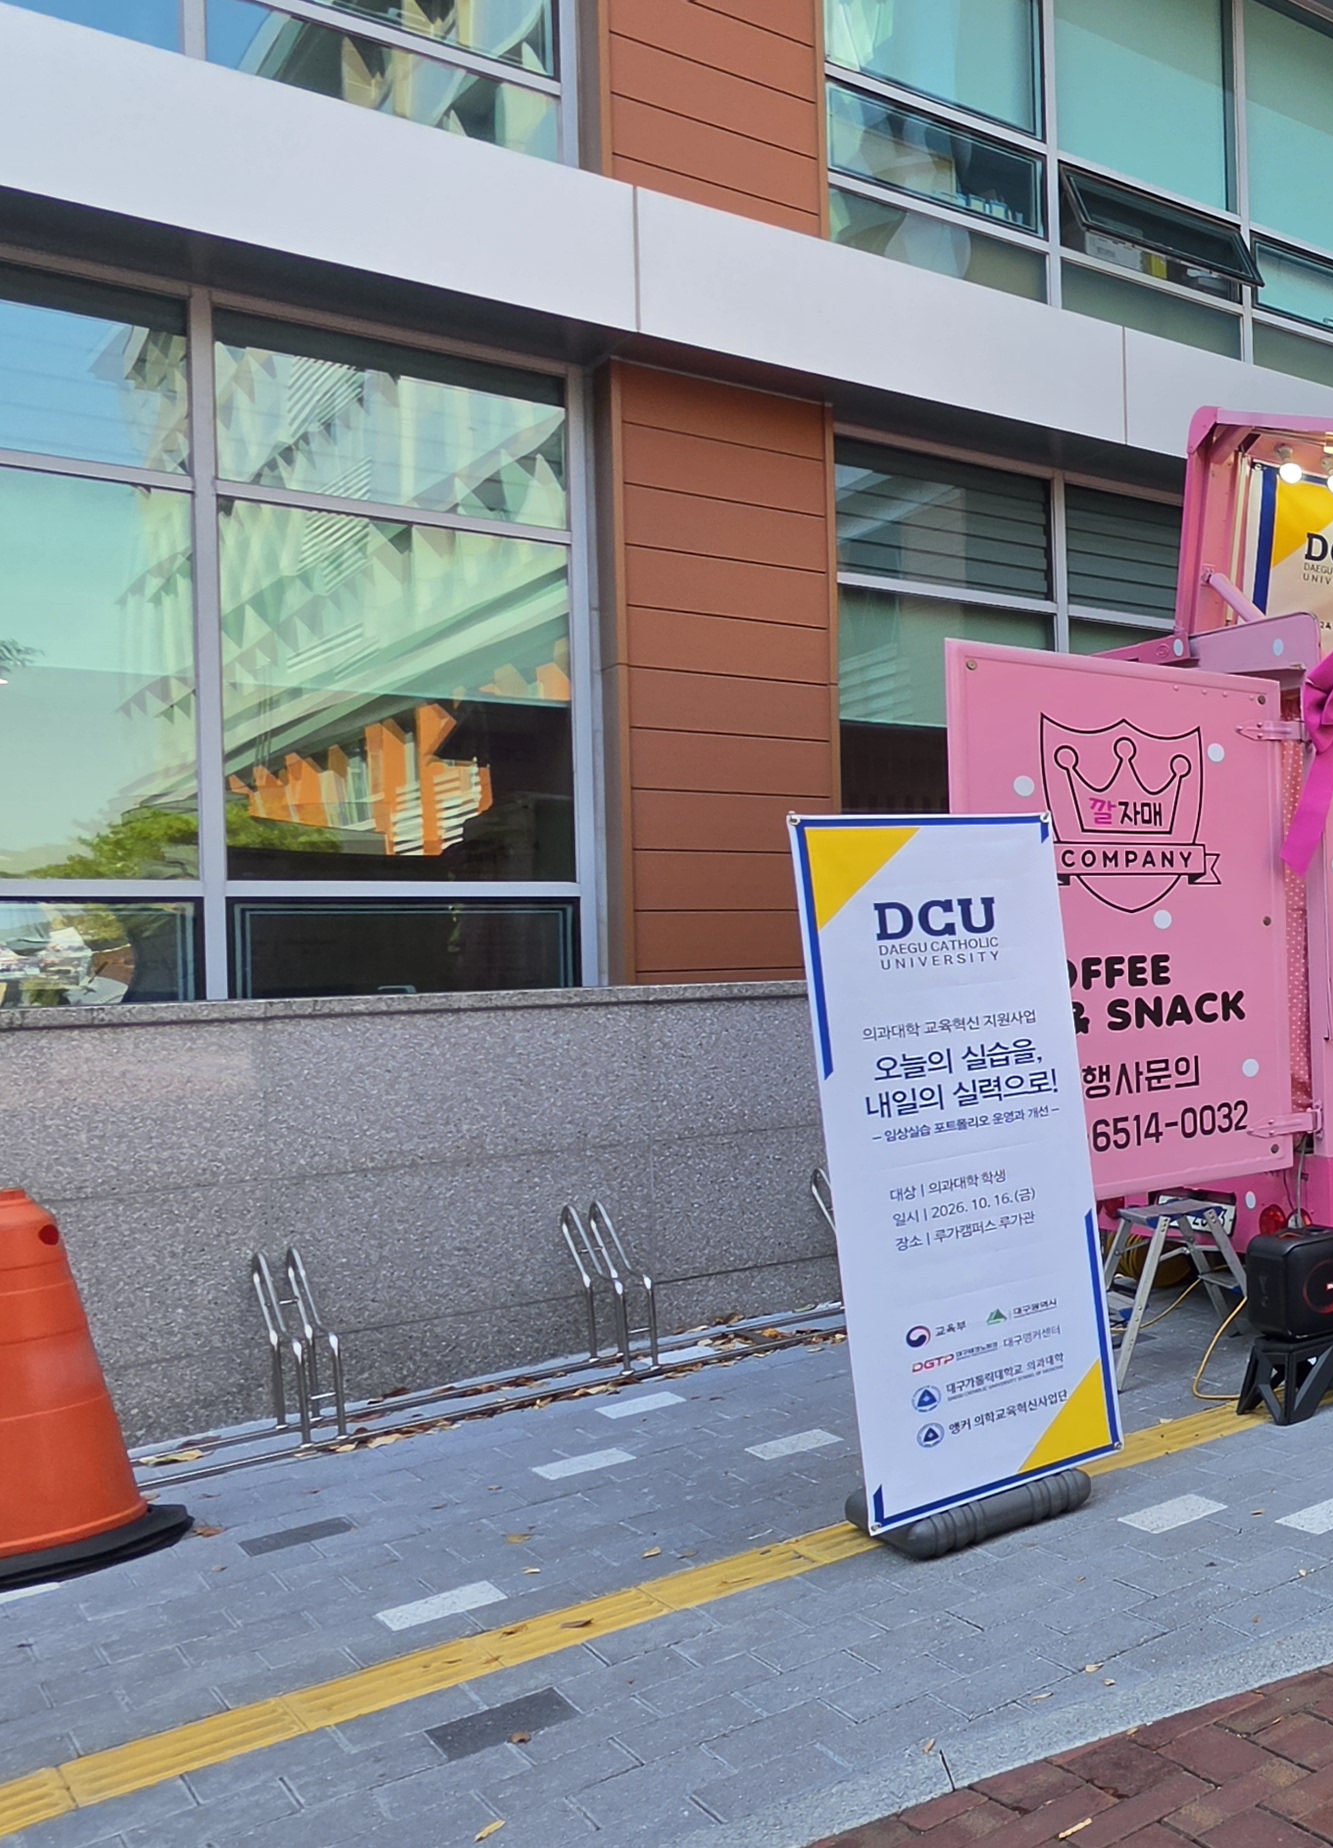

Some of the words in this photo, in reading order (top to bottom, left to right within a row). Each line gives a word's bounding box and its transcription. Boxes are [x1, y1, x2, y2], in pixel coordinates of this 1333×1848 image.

[1304, 562, 1333, 576] DAEGU
[1088, 797, 1163, 827] 깔자매
[1061, 850, 1193, 869] COMPANY
[873, 896, 996, 941] DCU
[878, 942, 928, 957] DAEGU
[930, 937, 999, 953] CATHOLIC
[880, 951, 1000, 970] UNIVERSITY
[862, 1021, 920, 1041] 의과대학
[923, 1015, 980, 1035] 교육혁신
[983, 1009, 1036, 1029] 지원사업
[1107, 990, 1246, 1031] SNACK
[874, 1048, 953, 1081] 오늘의
[961, 1037, 1043, 1071] 실습을,
[865, 1084, 945, 1119] 내일의
[953, 1068, 1059, 1108] 실력으로!
[1082, 1055, 1200, 1099] 행사문의
[884, 1124, 931, 1143] 임상실습
[934, 1115, 991, 1134] 포트폴리오
[992, 1110, 1025, 1125] 운영과
[1028, 1105, 1049, 1119] 개선
[1087, 1100, 1248, 1152] 6514-0032
[890, 1186, 916, 1202] 대상
[928, 1174, 979, 1195] 의과대학
[981, 1169, 1007, 1185] 학생
[892, 1209, 920, 1227] 일시
[931, 1202, 969, 1219] 2026.
[972, 1197, 992, 1211] 10.
[895, 1235, 923, 1252] 장소
[934, 1219, 998, 1243] 루가캠퍼스
[999, 1210, 1035, 1228] 루가관
[1013, 1298, 1057, 1315] 대구광역시
[935, 1320, 967, 1337] 교육부
[912, 1354, 955, 1373] DGTP
[946, 1364, 1024, 1394] 대구가톨릭대학교
[1027, 1352, 1064, 1370] 의과대학
[948, 1418, 971, 1435] 앵커
[973, 1389, 1068, 1427] 의학교육혁신사업단
